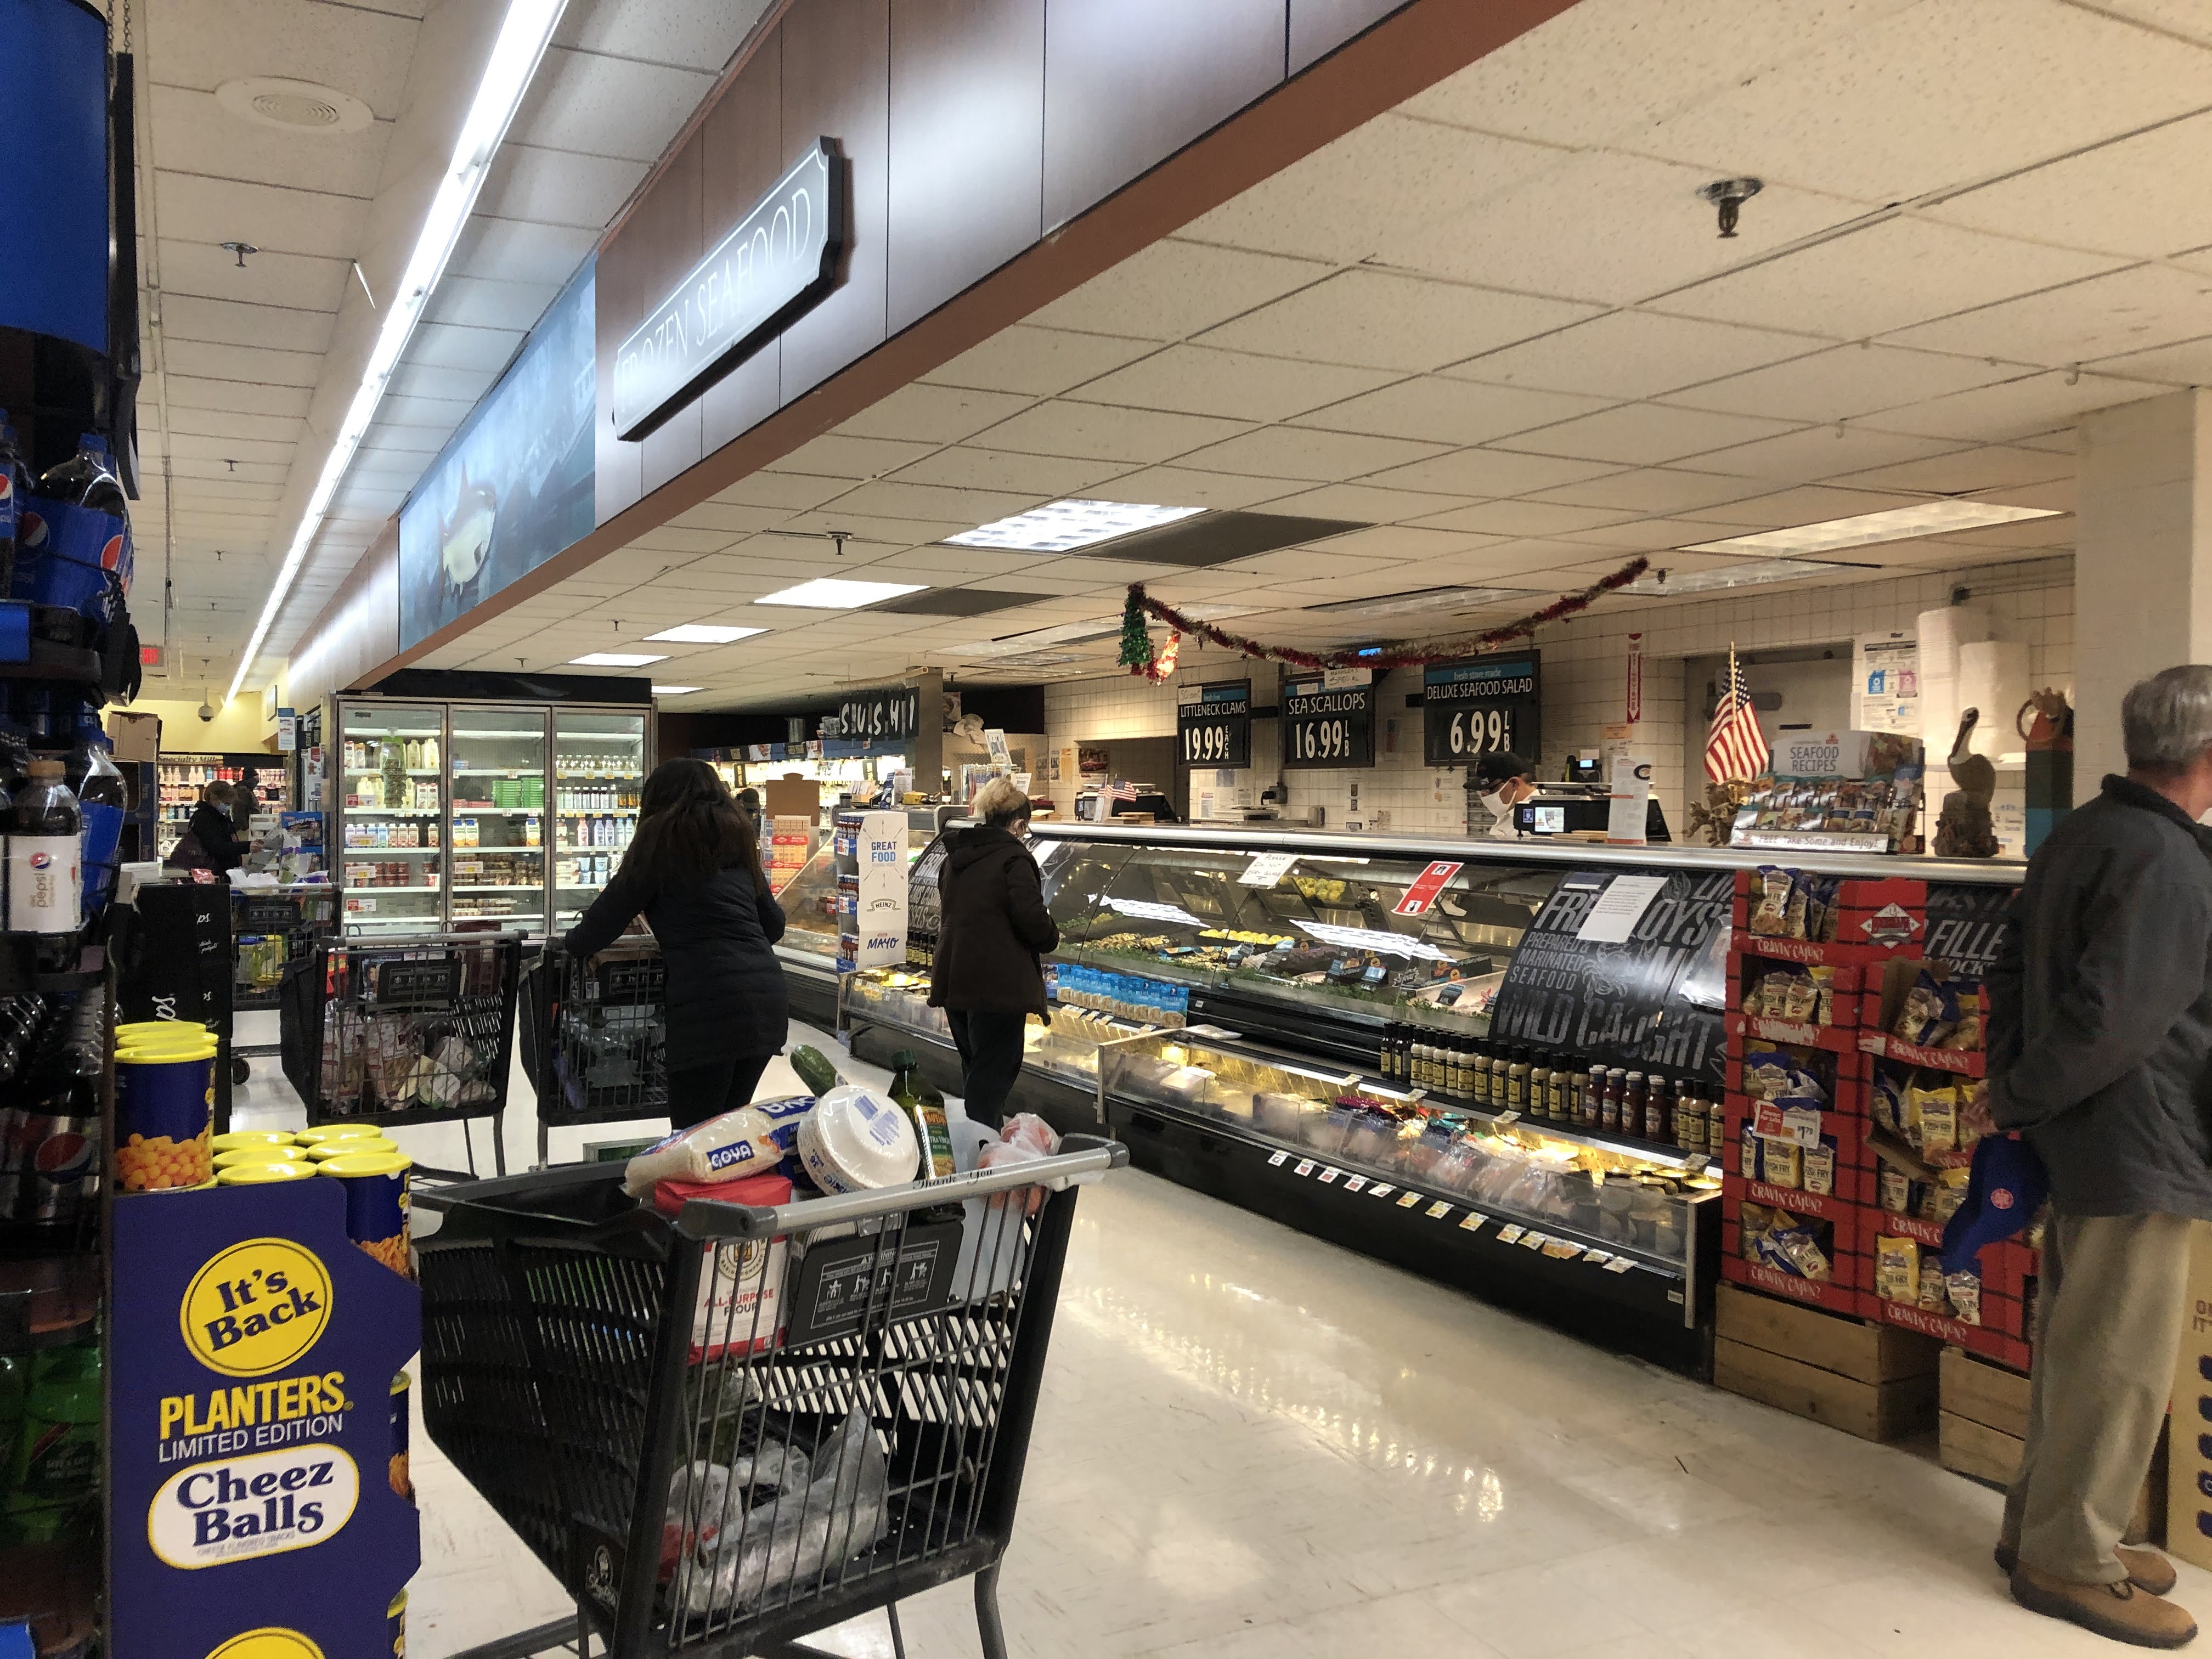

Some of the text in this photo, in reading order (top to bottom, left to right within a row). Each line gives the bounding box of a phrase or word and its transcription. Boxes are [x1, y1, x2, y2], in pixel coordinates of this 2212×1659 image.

[622, 187, 811, 413] FROZEN SEAFOOD
[1427, 678, 1533, 699] DELUXE SEAFOOD SALAD
[841, 695, 915, 736] SUSHI
[1181, 701, 1246, 718] LITTLENECK CLAMS
[1289, 692, 1365, 715] SEA SCALLOPS
[1185, 726, 1223, 760] 19.99
[1296, 720, 1342, 759] 16.99
[1450, 710, 1502, 754] 6.99
[1790, 746, 1839, 759] SEAFOOD
[1792, 759, 1837, 772] RECIPES
[871, 841, 897, 850] GREAT
[1805, 836, 1827, 846] Some
[1831, 837, 1847, 846] and
[871, 851, 896, 863] FOOD
[867, 937, 899, 950] MAYO
[1524, 932, 1581, 953] PREPARED
[1758, 939, 1824, 962] CRAVIN' CAJUN?
[1925, 919, 2007, 961] FILLE
[1517, 949, 1584, 972] MARINATED
[1509, 966, 1577, 991] SEAFOOD
[1497, 987, 1575, 1043] WILD
[711, 1144, 752, 1167] GOYA
[912, 1169, 992, 1190] Thank You
[1779, 1164, 1790, 1173] FRY
[1752, 1183, 1823, 1214] CRAVIN' CAJUN?
[1892, 1216, 1932, 1241] CRAVIN'
[216, 1269, 290, 1313] It's
[204, 1286, 322, 1352] Back
[1888, 1304, 1928, 1330] CRAVIN'
[160, 1372, 346, 1440] PLANTERS
[158, 1414, 343, 1464] LIMITED EDITION
[176, 1460, 334, 1511] Cheez
[193, 1495, 324, 1547] Balls
